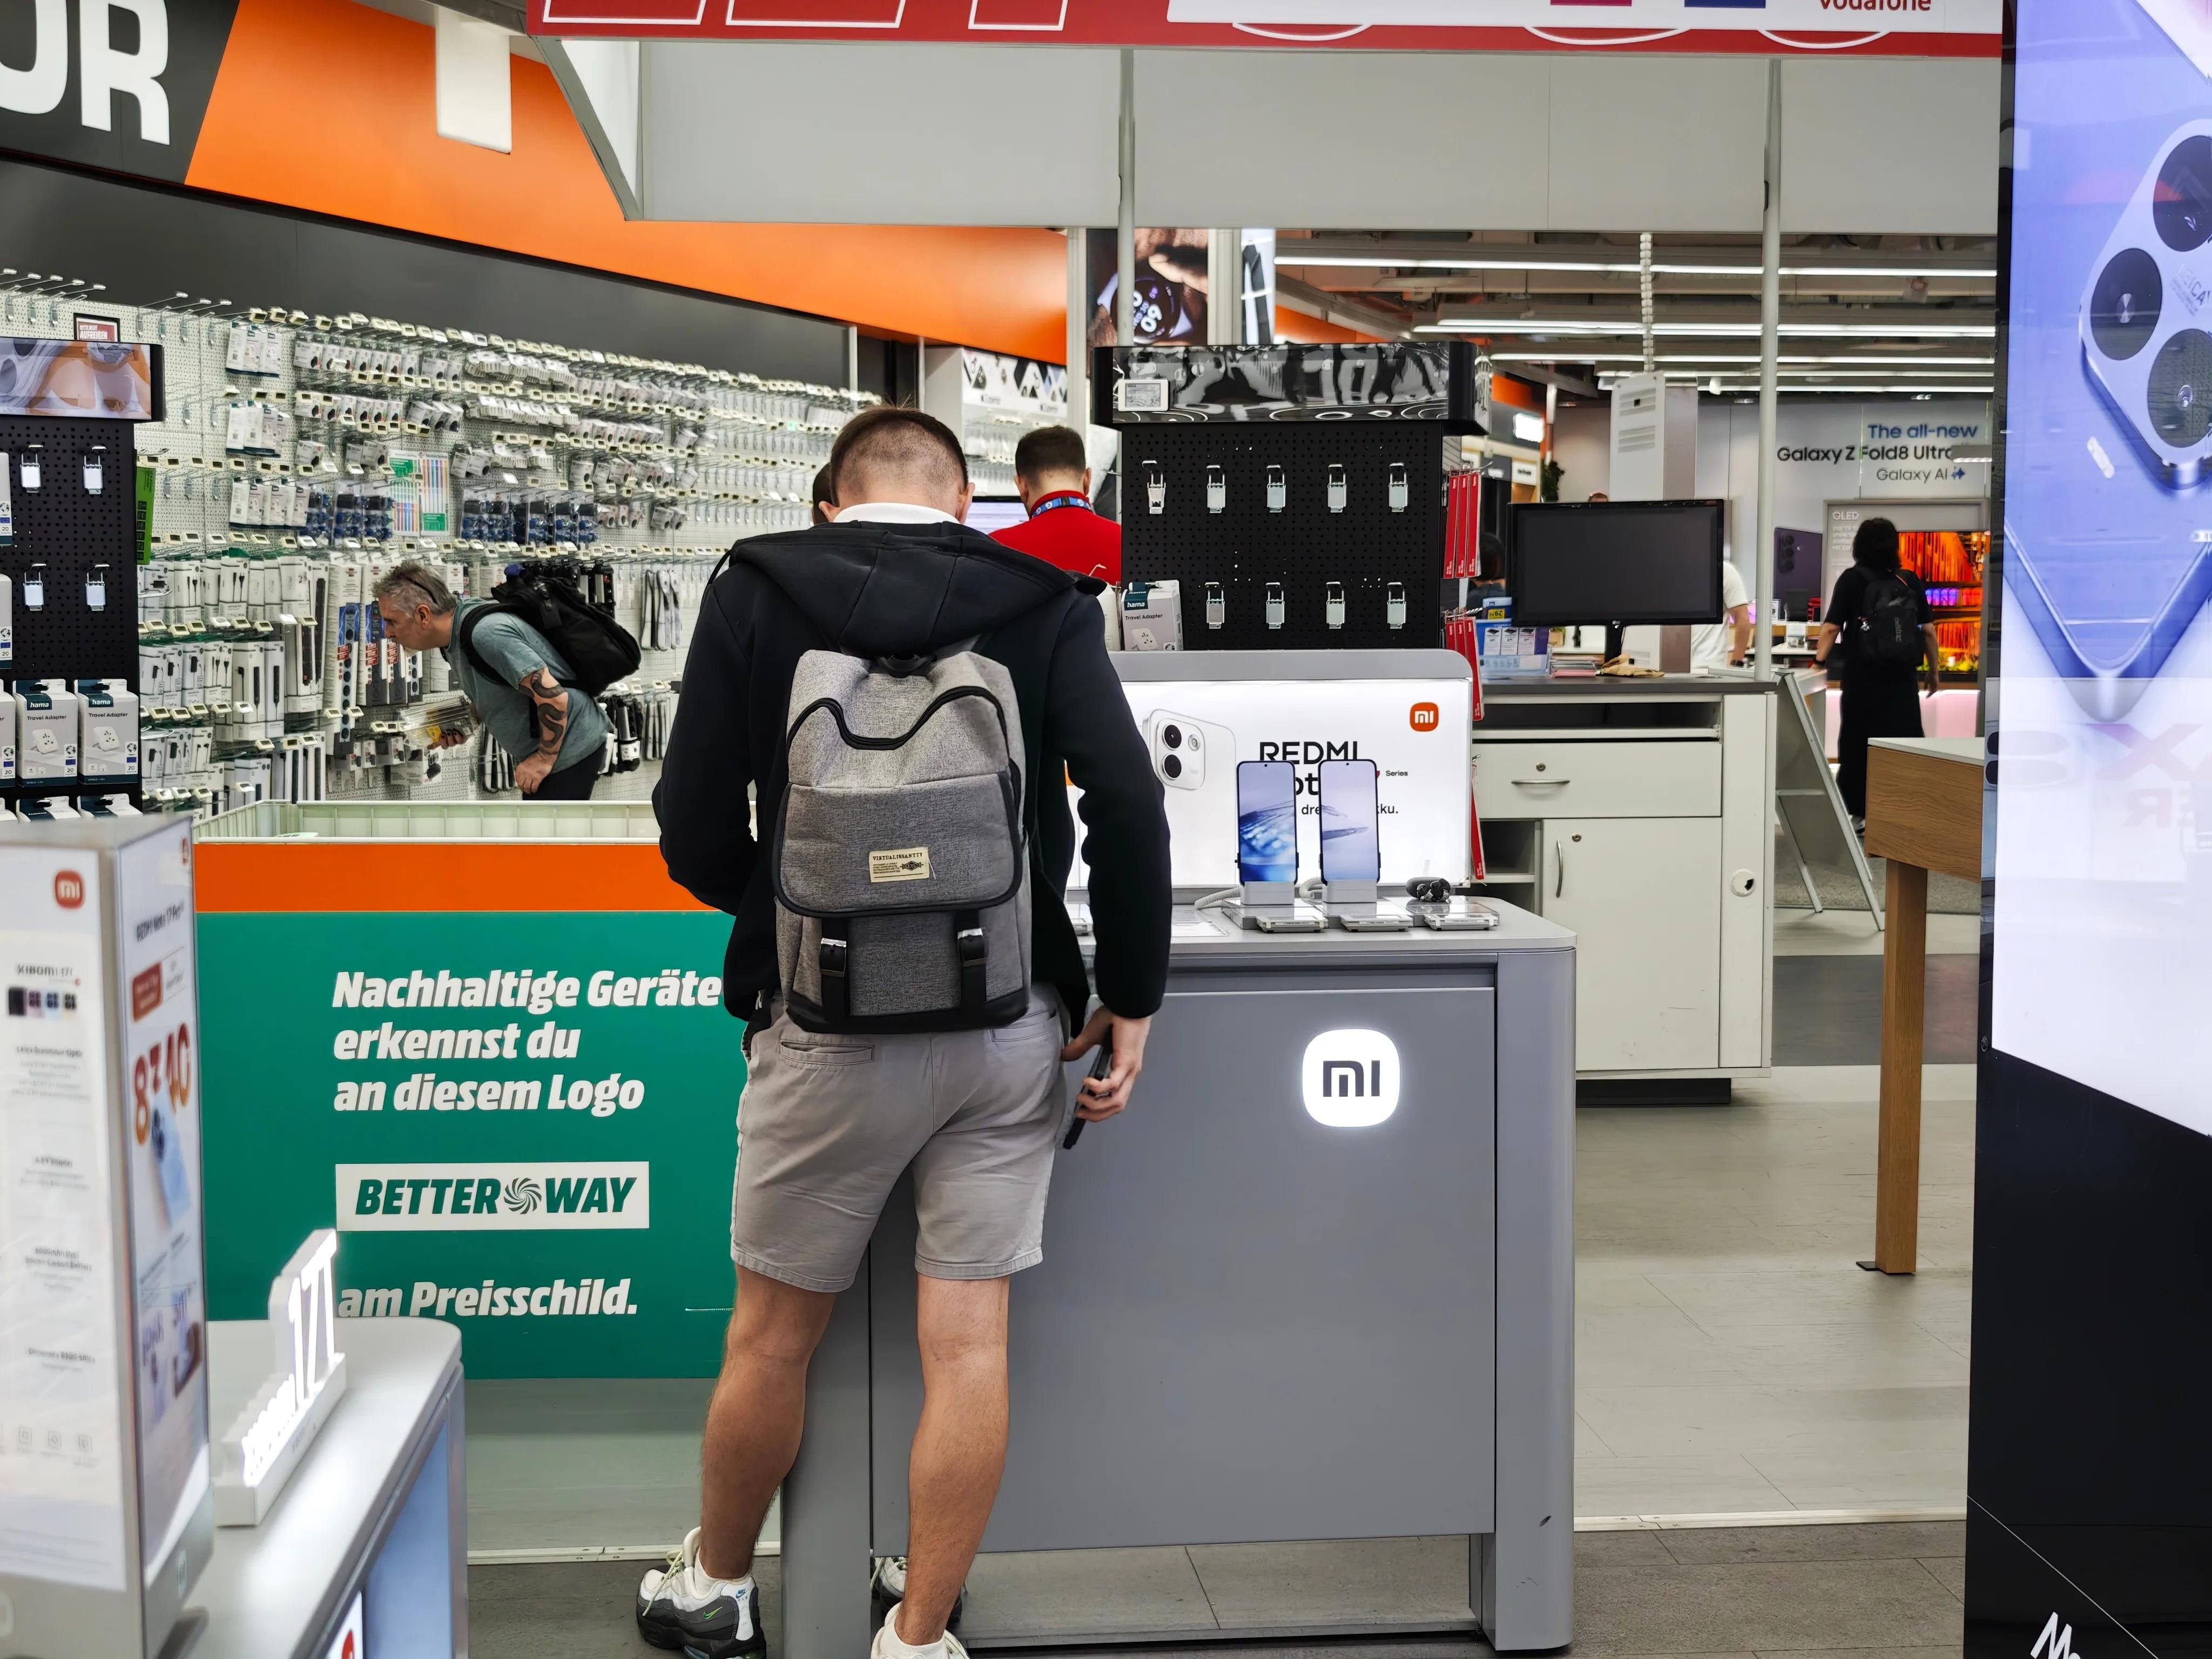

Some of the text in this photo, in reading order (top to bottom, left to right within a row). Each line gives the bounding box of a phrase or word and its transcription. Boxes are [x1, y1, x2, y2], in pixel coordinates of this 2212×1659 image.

[1868, 424, 1978, 438] The all-new
[1777, 447, 1843, 464] Galaxy
[1845, 447, 1854, 460] Z
[1860, 446, 1908, 460] Fold8
[1877, 468, 1947, 483] Galaxy AI
[1259, 741, 1358, 765] REDMI
[332, 969, 722, 1014] Nachhaltige Geräte
[333, 1021, 582, 1060] erkennst du
[333, 1073, 645, 1117] an diesem Logo
[355, 1177, 637, 1215] BETTER WAY
[338, 1278, 638, 1318] am Preisschild.
